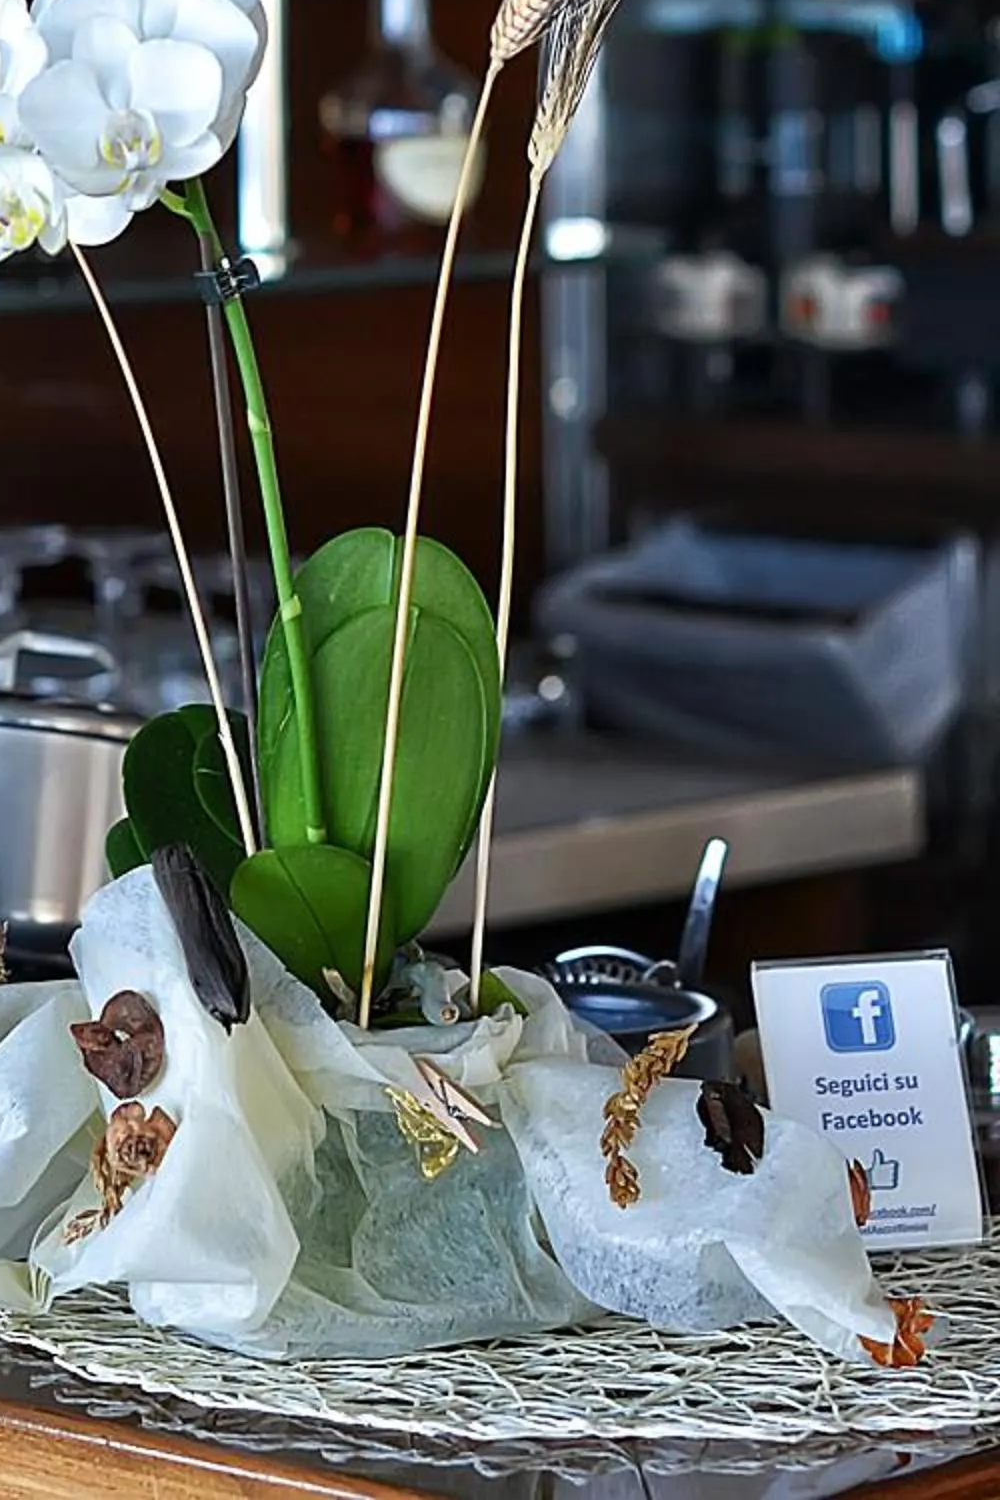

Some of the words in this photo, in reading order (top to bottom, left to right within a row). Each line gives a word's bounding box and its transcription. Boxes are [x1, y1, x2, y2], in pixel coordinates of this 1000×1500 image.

[851, 988, 882, 1045] f
[814, 1072, 889, 1098] Seguici
[895, 1073, 919, 1091] su
[821, 1106, 924, 1132] Facebook
